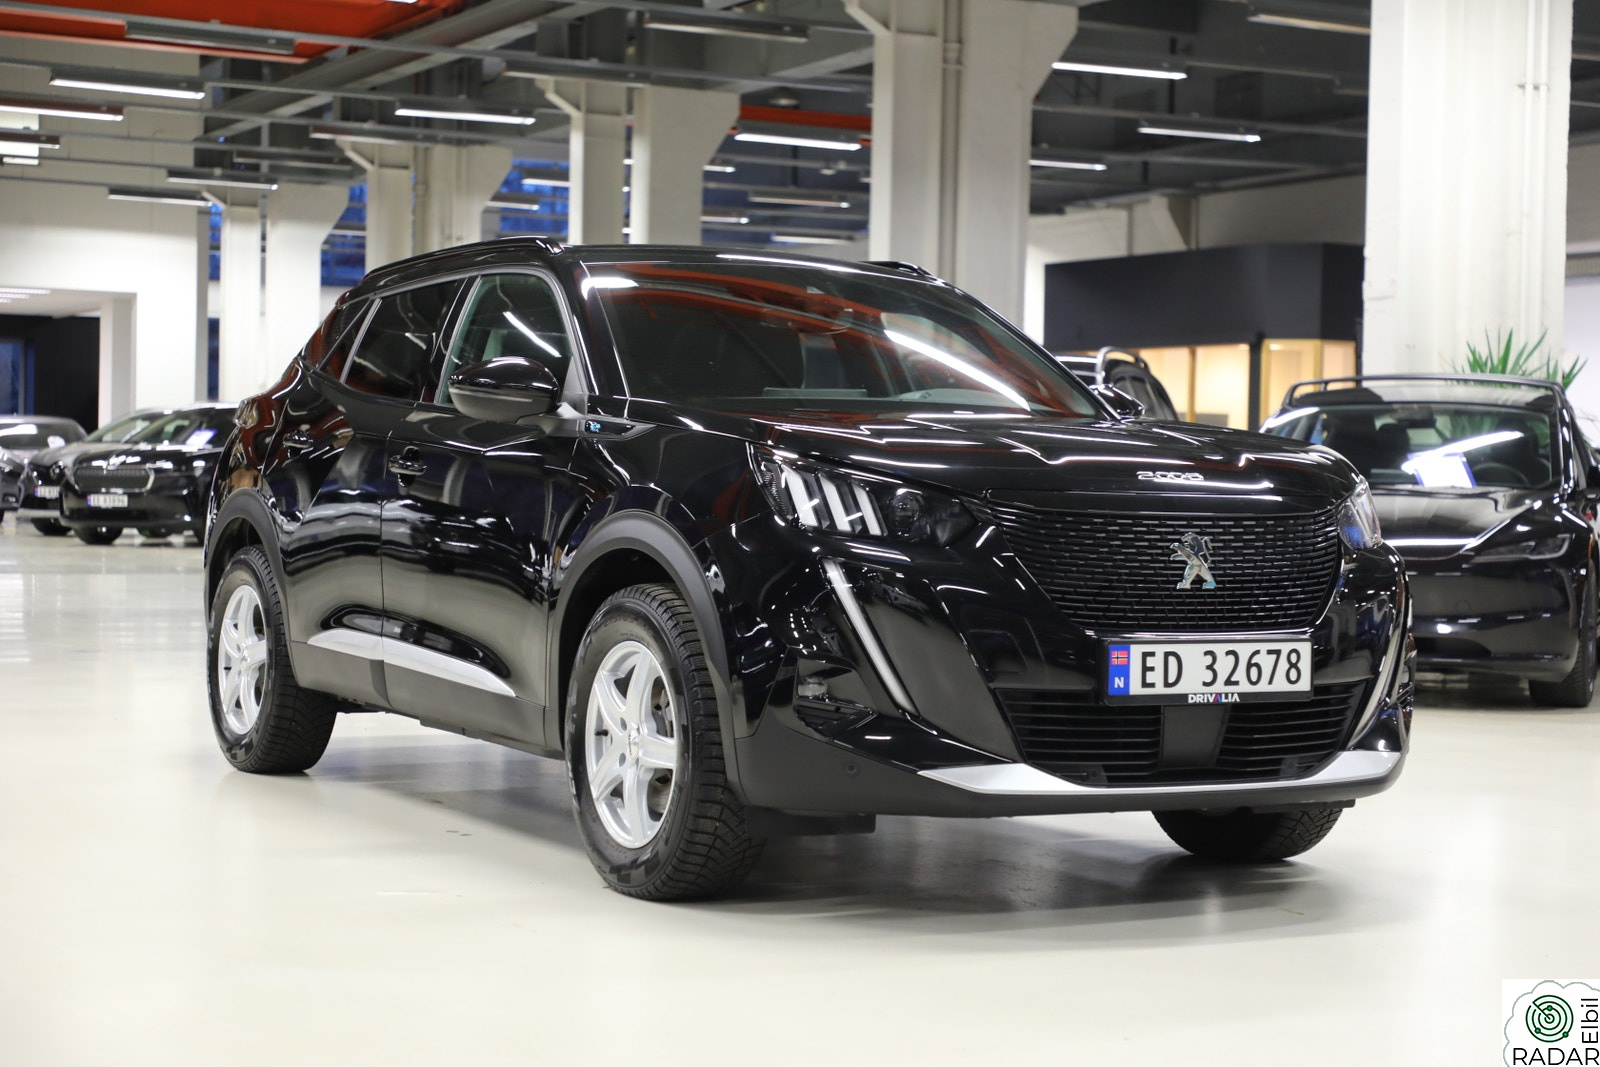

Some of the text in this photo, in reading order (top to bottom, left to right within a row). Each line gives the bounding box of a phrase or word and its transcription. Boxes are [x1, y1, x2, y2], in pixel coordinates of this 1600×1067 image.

[1141, 648, 1301, 689] ED 32678
[1114, 677, 1124, 688] N
[1188, 692, 1240, 704] DRIVALIA
